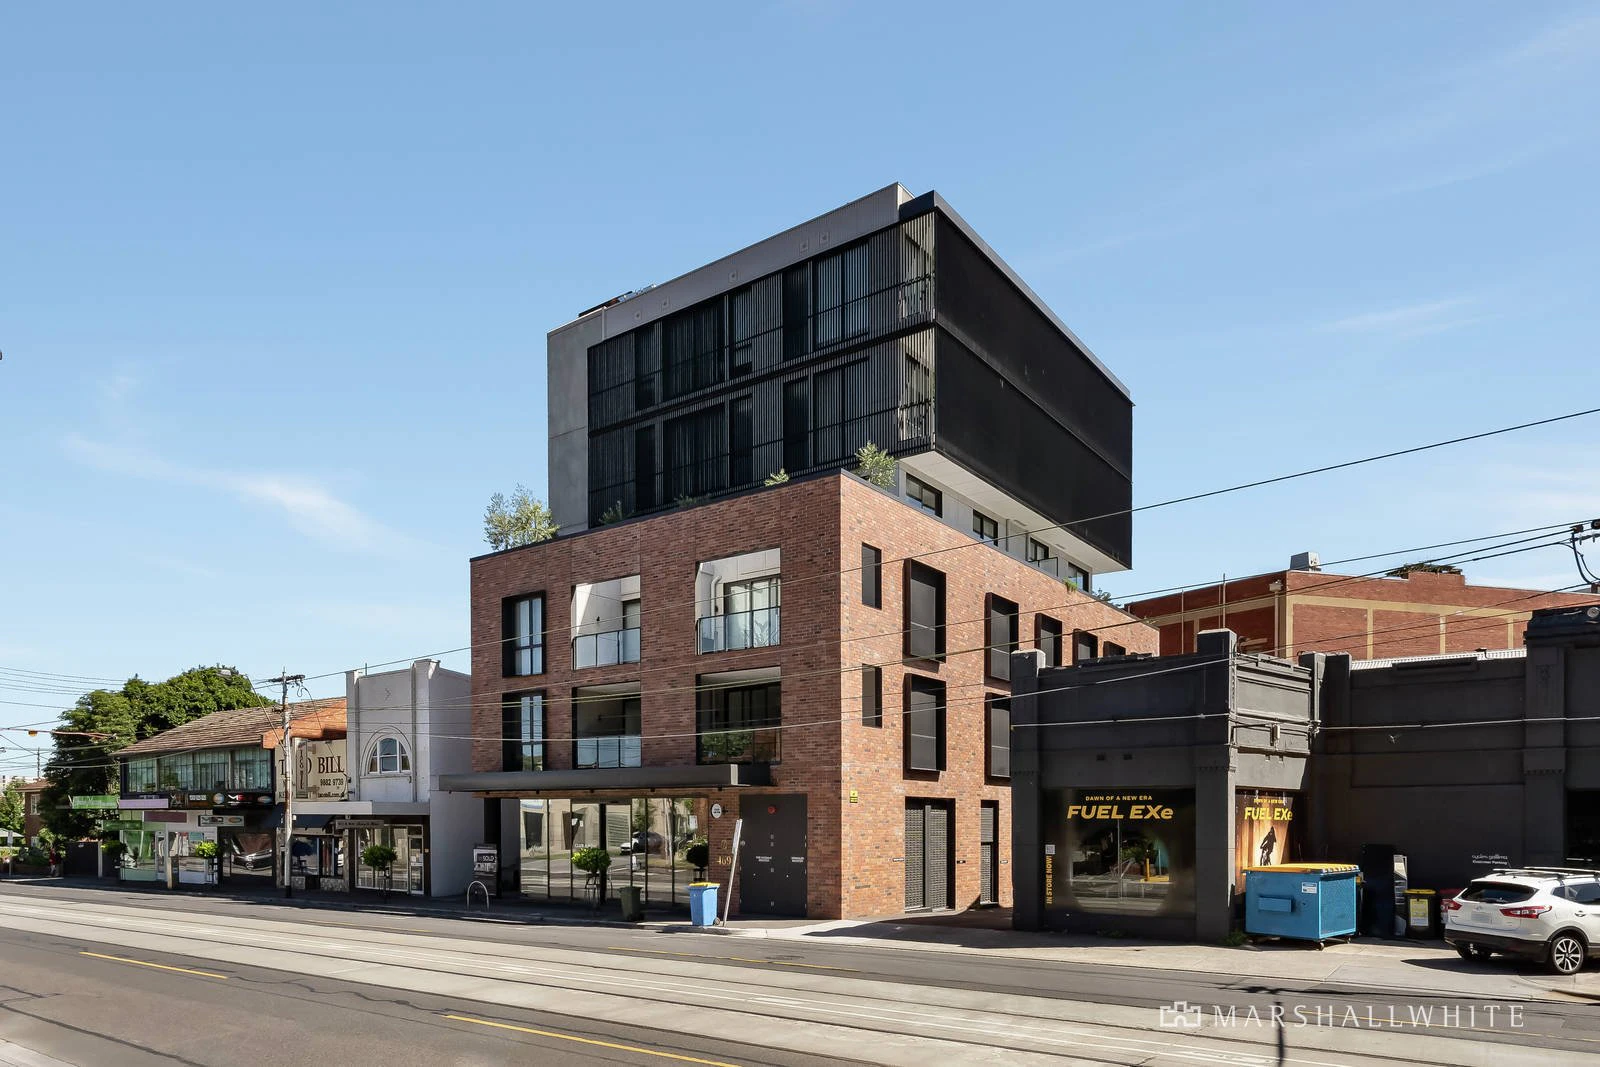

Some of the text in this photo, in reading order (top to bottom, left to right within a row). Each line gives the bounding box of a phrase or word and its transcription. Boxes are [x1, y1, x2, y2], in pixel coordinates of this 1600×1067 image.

[318, 756, 344, 773] BILL
[1067, 805, 1174, 819] FUEL EXe
[1244, 806, 1272, 820] FUEL
